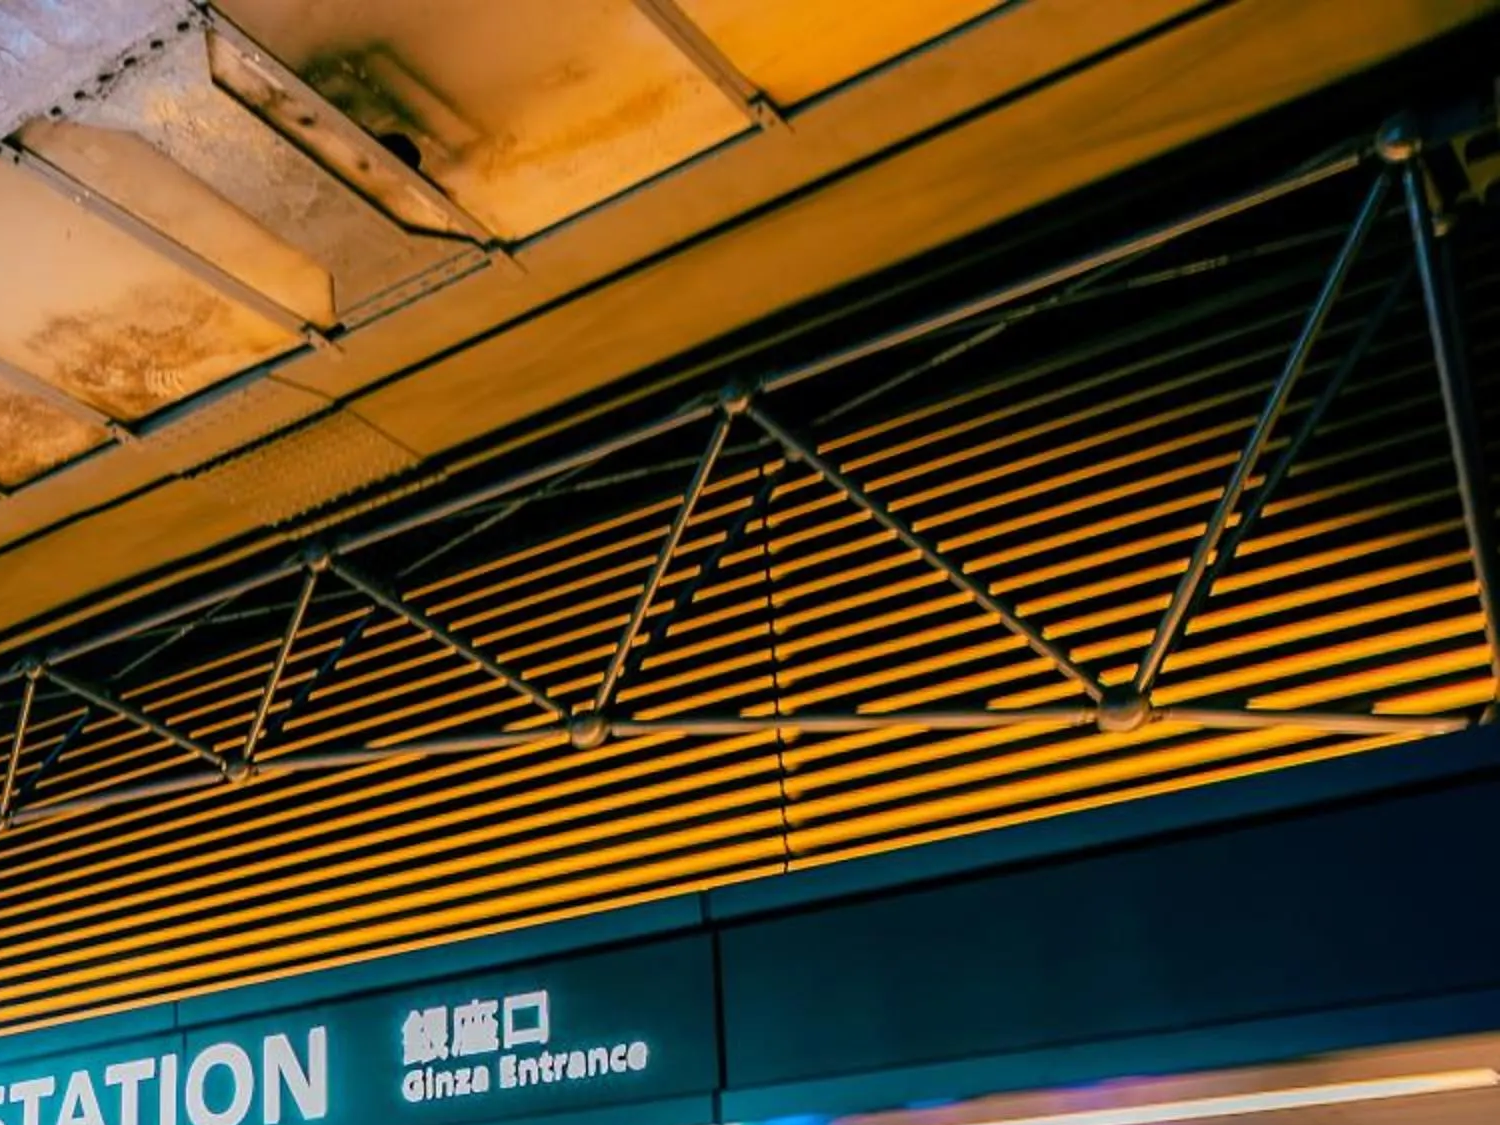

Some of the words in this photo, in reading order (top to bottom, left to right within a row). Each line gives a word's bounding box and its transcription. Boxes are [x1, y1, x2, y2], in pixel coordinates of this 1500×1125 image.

[402, 989, 549, 1065] 銀座口
[402, 1066, 490, 1102] Ginza
[500, 1042, 649, 1088] Entrance
